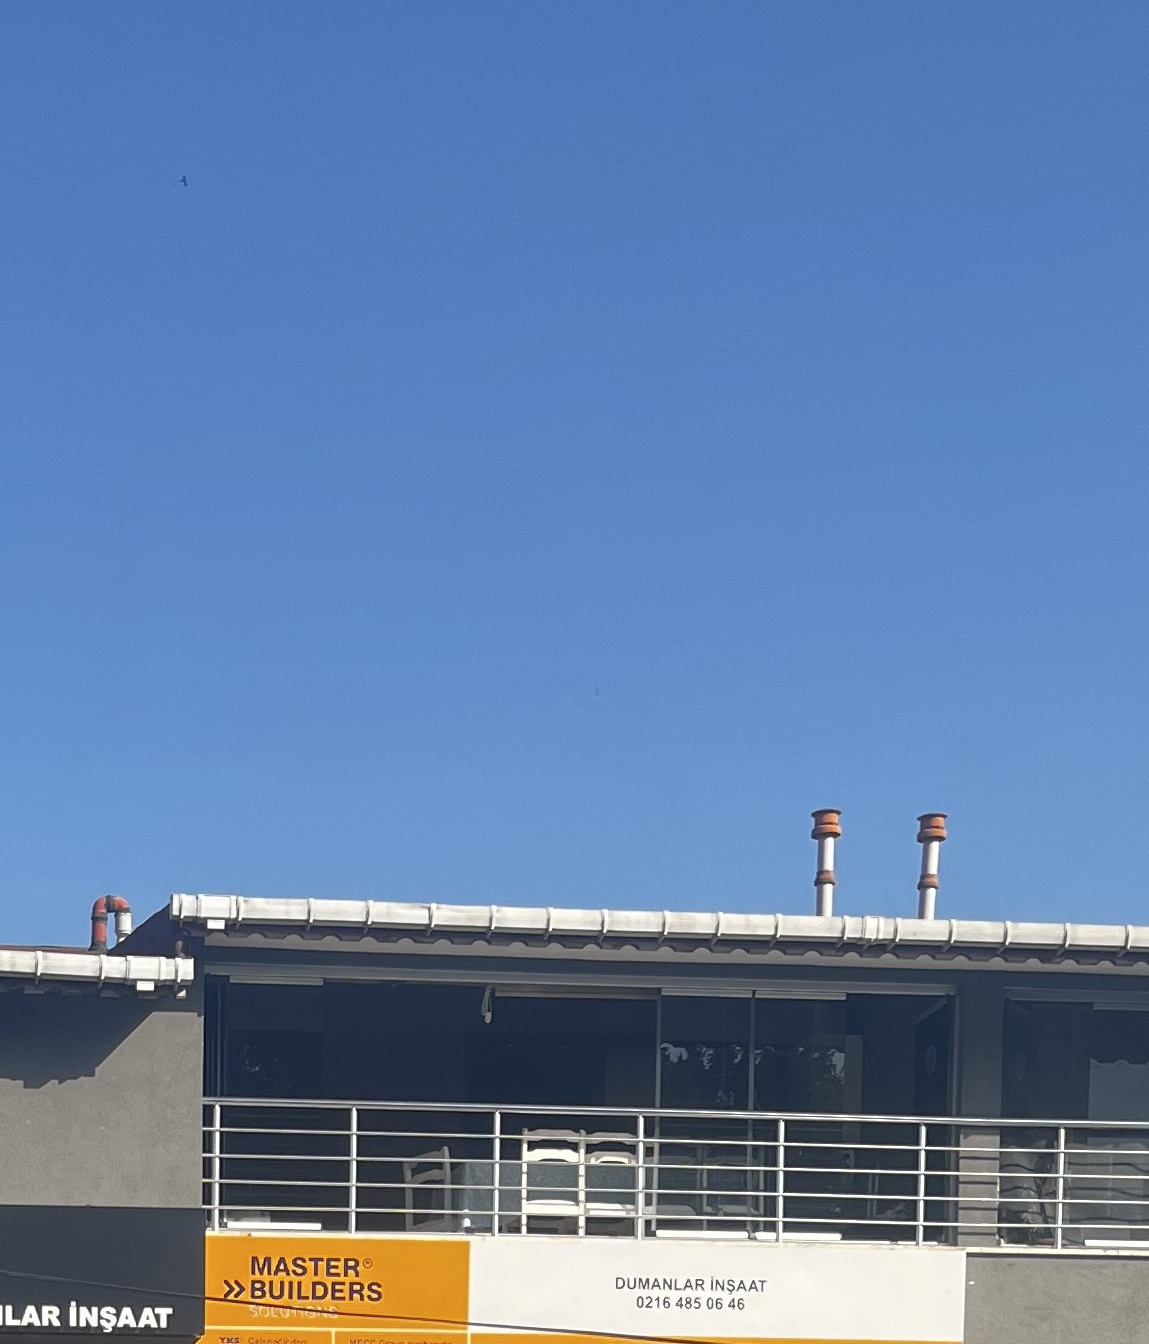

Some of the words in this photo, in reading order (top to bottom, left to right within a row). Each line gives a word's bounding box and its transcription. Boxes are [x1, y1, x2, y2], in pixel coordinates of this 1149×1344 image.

[250, 1280, 383, 1302] BUILDERS
[614, 1276, 706, 1292] DUMANLAR
[709, 1275, 768, 1295] İNŞAAT
[636, 1295, 671, 1309] 0216
[675, 1296, 702, 1310] 485
[706, 1297, 724, 1311] 06
[727, 1297, 746, 1311] 46
[68, 1300, 174, 1333] İNŞAAT
